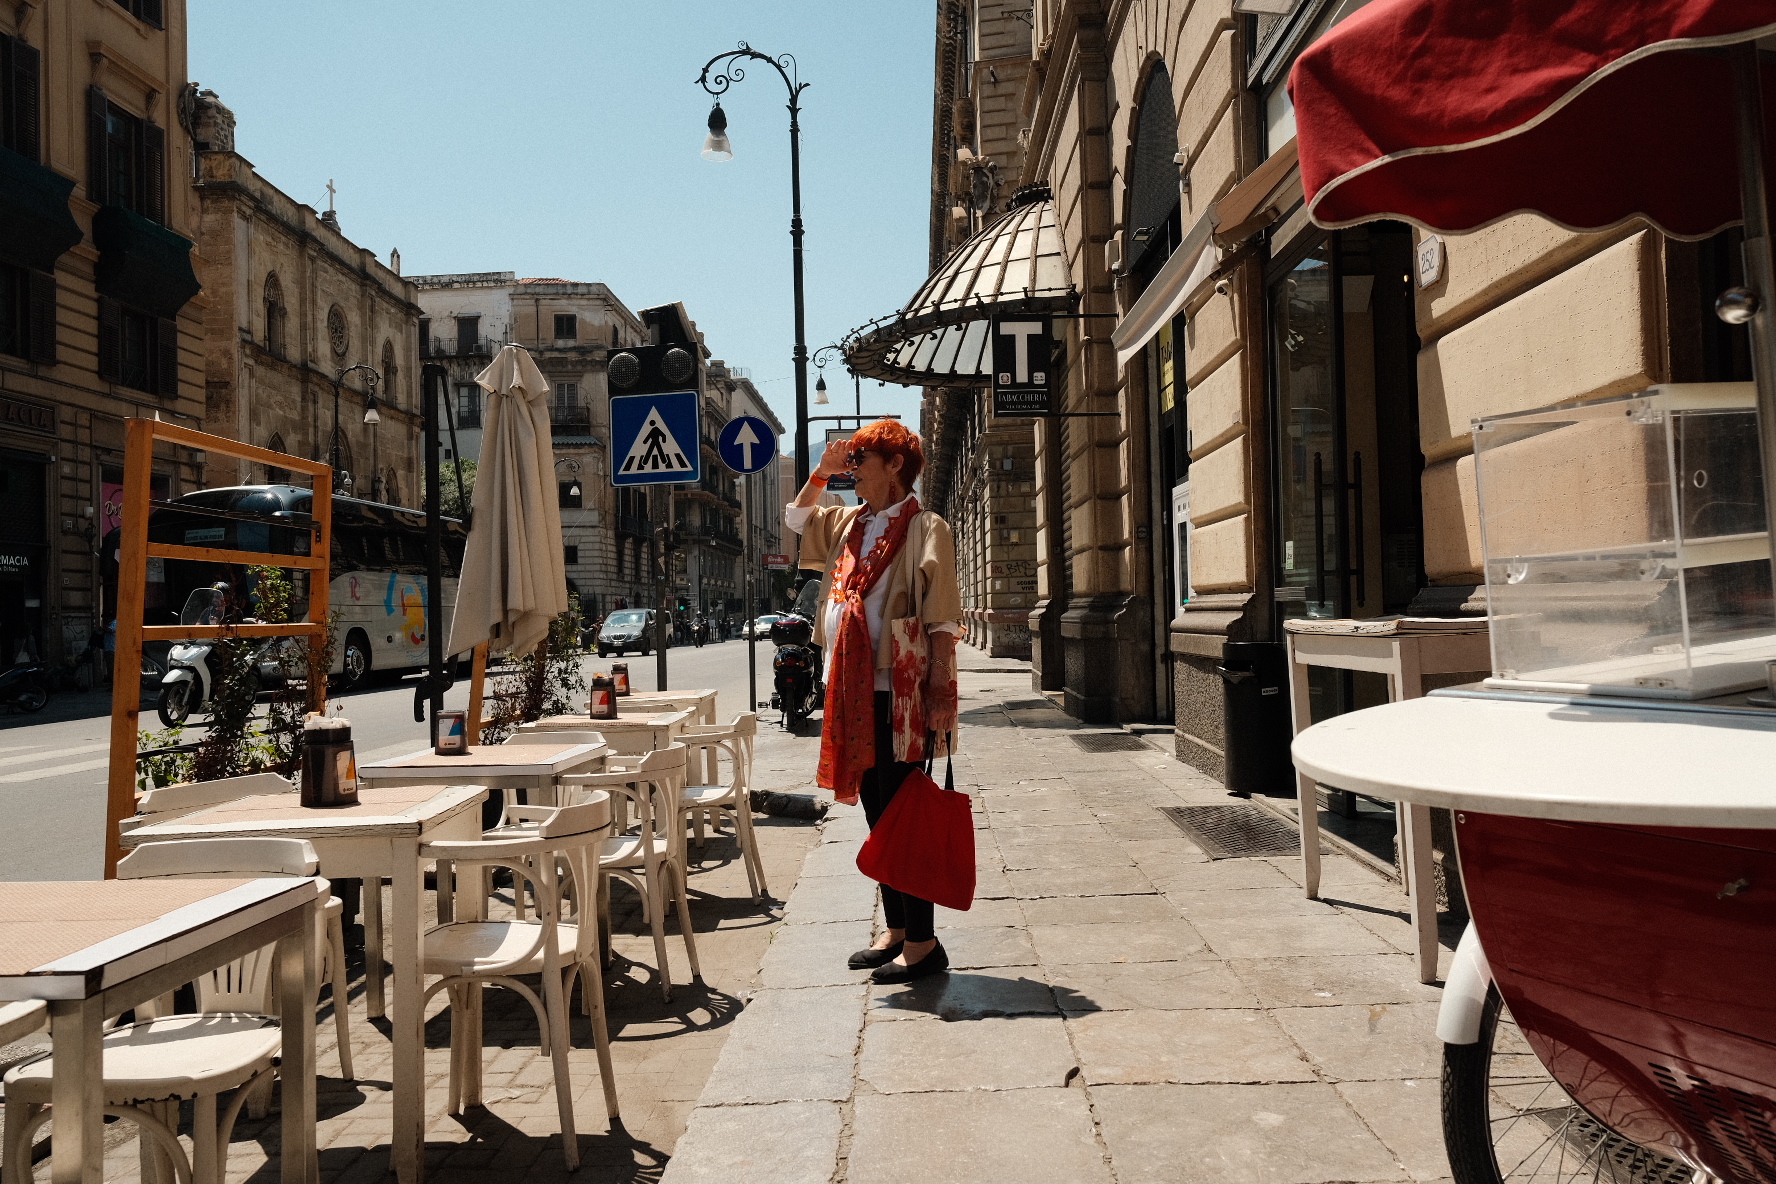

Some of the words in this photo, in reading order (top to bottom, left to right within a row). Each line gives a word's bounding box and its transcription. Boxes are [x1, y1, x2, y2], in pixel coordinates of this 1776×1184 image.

[1421, 248, 1435, 275] 252
[1000, 322, 1042, 383] T
[998, 393, 1047, 402] TABACCHERIA
[0, 555, 29, 566] MACIA
